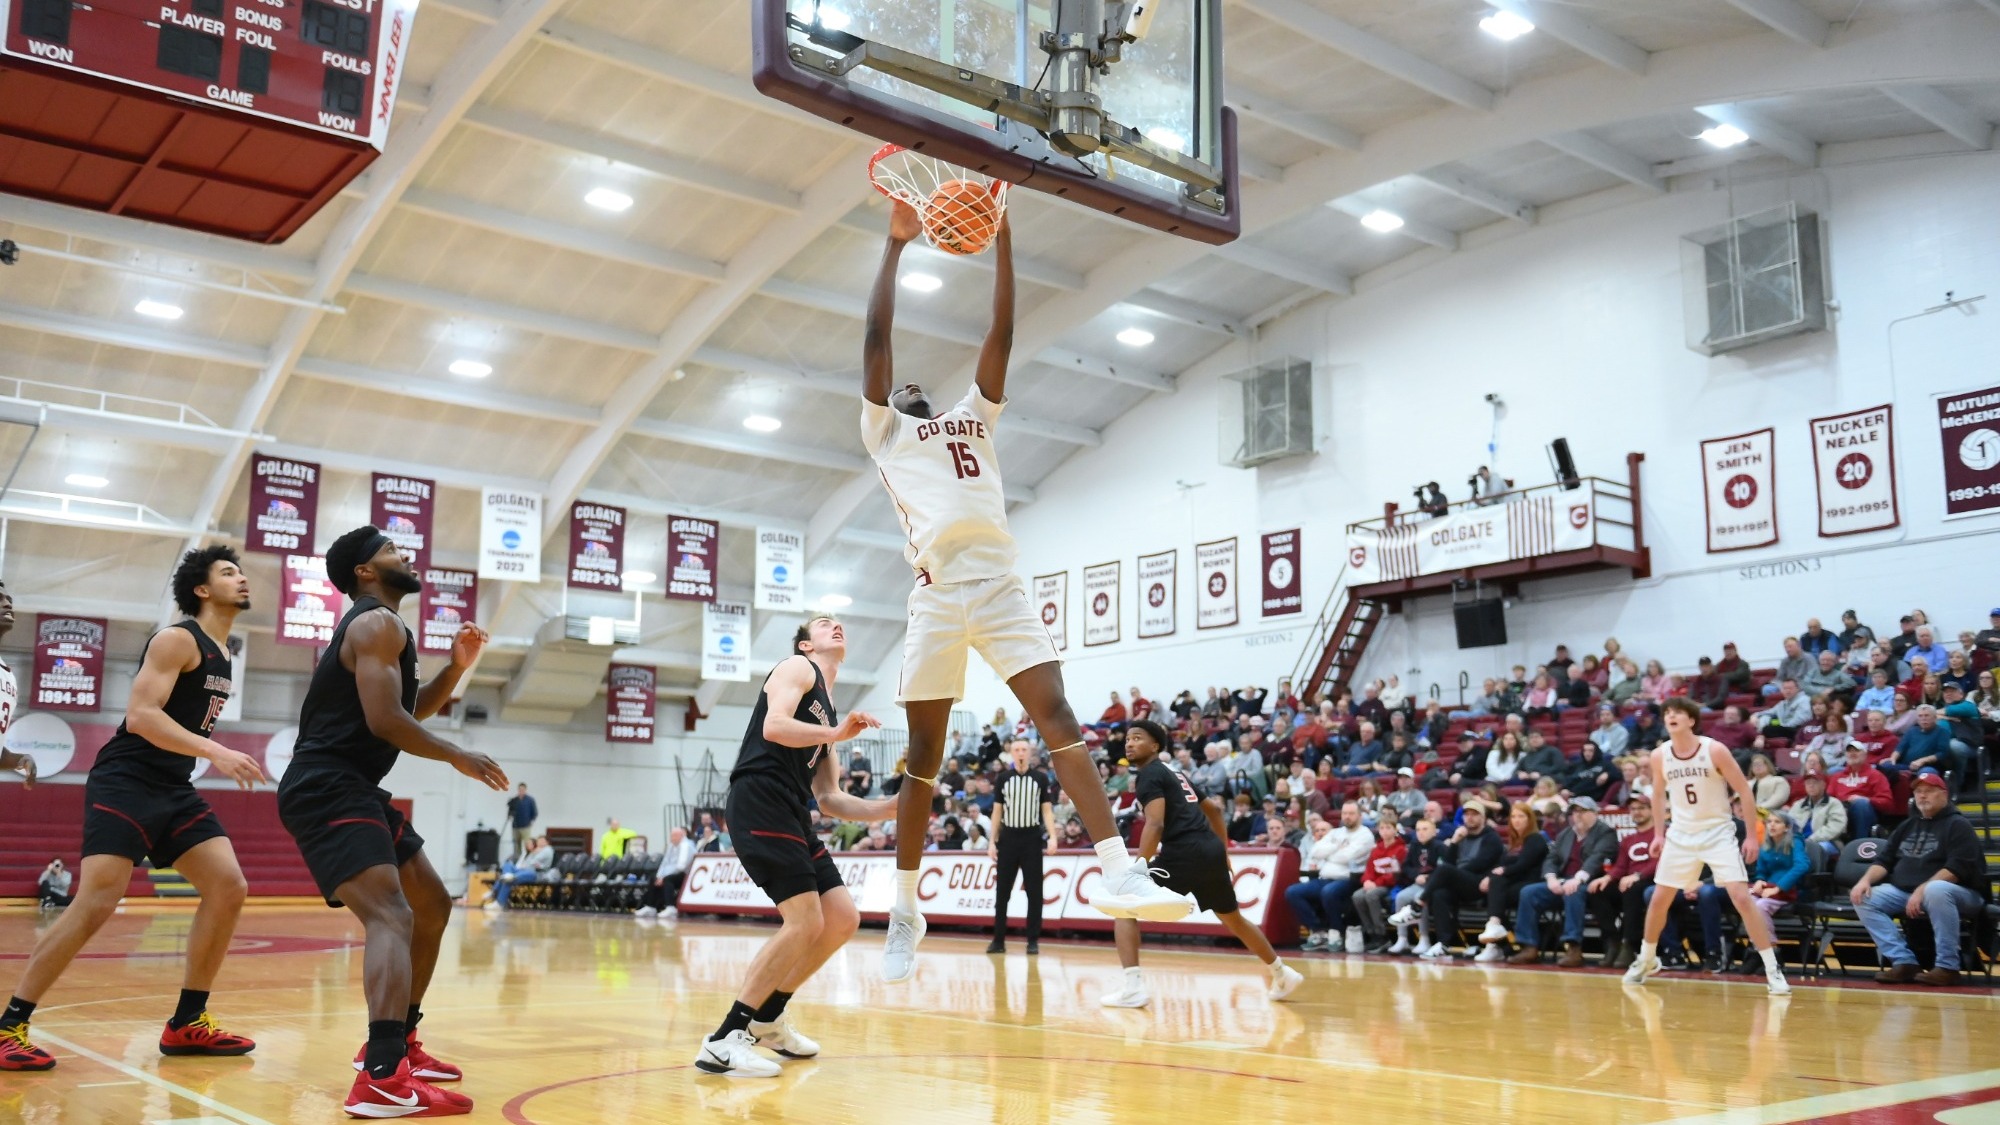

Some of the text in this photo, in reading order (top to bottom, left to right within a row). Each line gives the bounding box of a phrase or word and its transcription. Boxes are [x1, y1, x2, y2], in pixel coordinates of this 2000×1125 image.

[161, 6, 225, 36] PLAYER
[235, 7, 282, 31] BONUS
[236, 28, 277, 50] FOUL
[28, 39, 73, 63] WON
[322, 51, 371, 75] FOULS
[206, 85, 254, 107] GAME
[318, 112, 356, 132] WON
[917, 419, 985, 442] COGATE
[1818, 413, 1885, 436] TUCKER
[1724, 441, 1752, 454] JEN
[1826, 430, 1879, 450] NEALE
[1977, 441, 1986, 458] 1
[946, 442, 980, 479] 15
[1716, 454, 1762, 470] SMITH
[257, 460, 315, 483] COLGATE
[1842, 461, 1866, 482] 20
[376, 478, 431, 499] COLGATE
[1731, 482, 1751, 501] 10
[488, 493, 536, 511] COLGATE
[1826, 500, 1890, 518] 1992-1995
[575, 506, 623, 526] COLGATE
[671, 520, 715, 538] COLGATE
[1431, 520, 1493, 547] COLGATE
[761, 533, 799, 548] COLGATE
[496, 561, 524, 573] 2023
[1739, 558, 1822, 580] SECTION 3
[426, 570, 474, 587] COLGATE
[572, 569, 620, 586] 2023-24
[670, 581, 714, 596] 2023-24
[769, 593, 791, 604] 2024
[708, 602, 746, 616] COLGATE
[1245, 633, 1285, 649] SECTION
[716, 663, 737, 673] 2019
[38, 689, 96, 706] 1994-95
[1667, 767, 1710, 780] COLGATE
[1175, 772, 1198, 803] 3
[1685, 784, 1698, 805] 6
[1628, 842, 1650, 862] C
[690, 866, 708, 893] C
[917, 867, 943, 901] C
